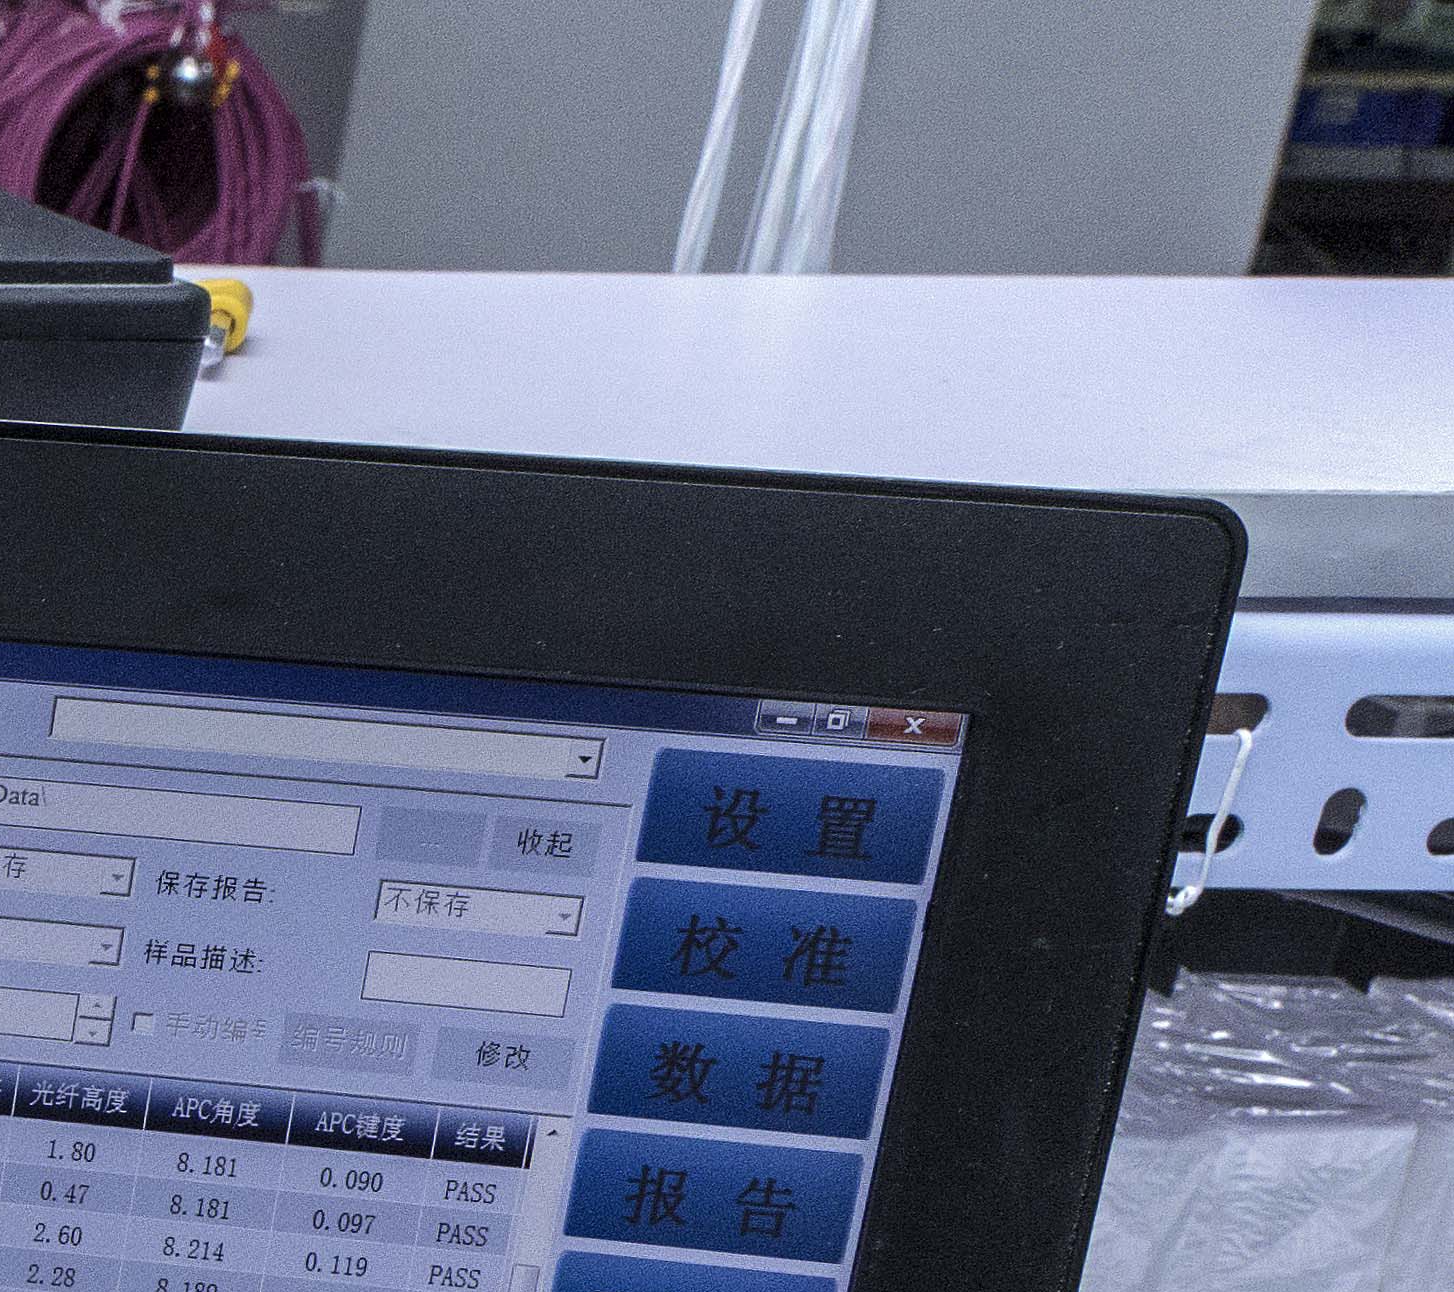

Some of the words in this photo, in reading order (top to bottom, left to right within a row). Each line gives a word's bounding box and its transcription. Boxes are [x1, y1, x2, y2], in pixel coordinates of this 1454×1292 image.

[518, 829, 572, 858] 收起
[388, 887, 470, 917] 不保存
[477, 1042, 530, 1069] 修改
[30, 1082, 128, 1114] 光纤高度
[172, 1098, 261, 1128] APC角度
[315, 1111, 405, 1143] APC键度
[455, 1122, 506, 1151] 结果
[48, 1140, 96, 1162] 1.80
[177, 1152, 236, 1177] 8.181
[320, 1167, 383, 1192] 0.090
[444, 1180, 497, 1204] PASS
[40, 1181, 89, 1204] 0.47
[170, 1194, 229, 1220] 8.181
[313, 1210, 376, 1234] 0.097
[436, 1222, 489, 1246] PASS
[34, 1223, 82, 1246] 2.60
[163, 1236, 223, 1262] 8.214
[305, 1252, 368, 1277] 0.119
[429, 1263, 481, 1289] PASS
